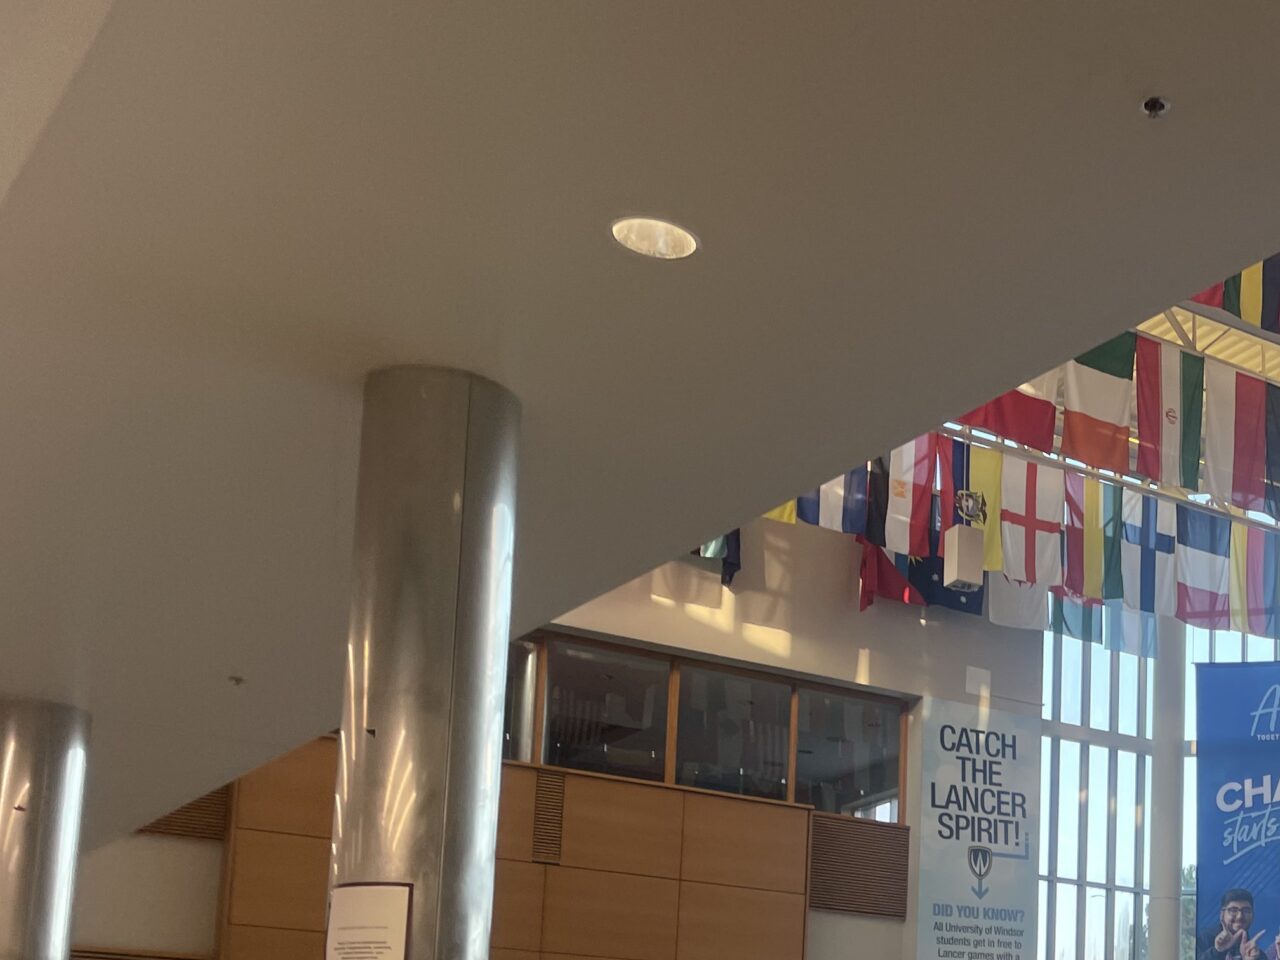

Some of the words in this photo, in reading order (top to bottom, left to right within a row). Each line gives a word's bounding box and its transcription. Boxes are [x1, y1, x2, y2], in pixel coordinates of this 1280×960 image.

[940, 724, 1017, 760] CATCH
[956, 756, 1002, 787] THE
[931, 782, 1027, 819] LANCER
[938, 812, 1020, 847] SPIRIT!
[933, 903, 953, 917] DID
[956, 905, 980, 920] YOU
[983, 907, 1025, 922] KNOW?
[933, 922, 943, 932] All
[945, 922, 984, 936] University
[985, 925, 993, 935] of
[994, 926, 1025, 937] Windsor
[936, 935, 971, 946] students
[973, 938, 986, 949] get
[988, 938, 995, 948] in
[997, 938, 1013, 949] free
[1014, 940, 1022, 950] to
[938, 948, 965, 959] Lancer
